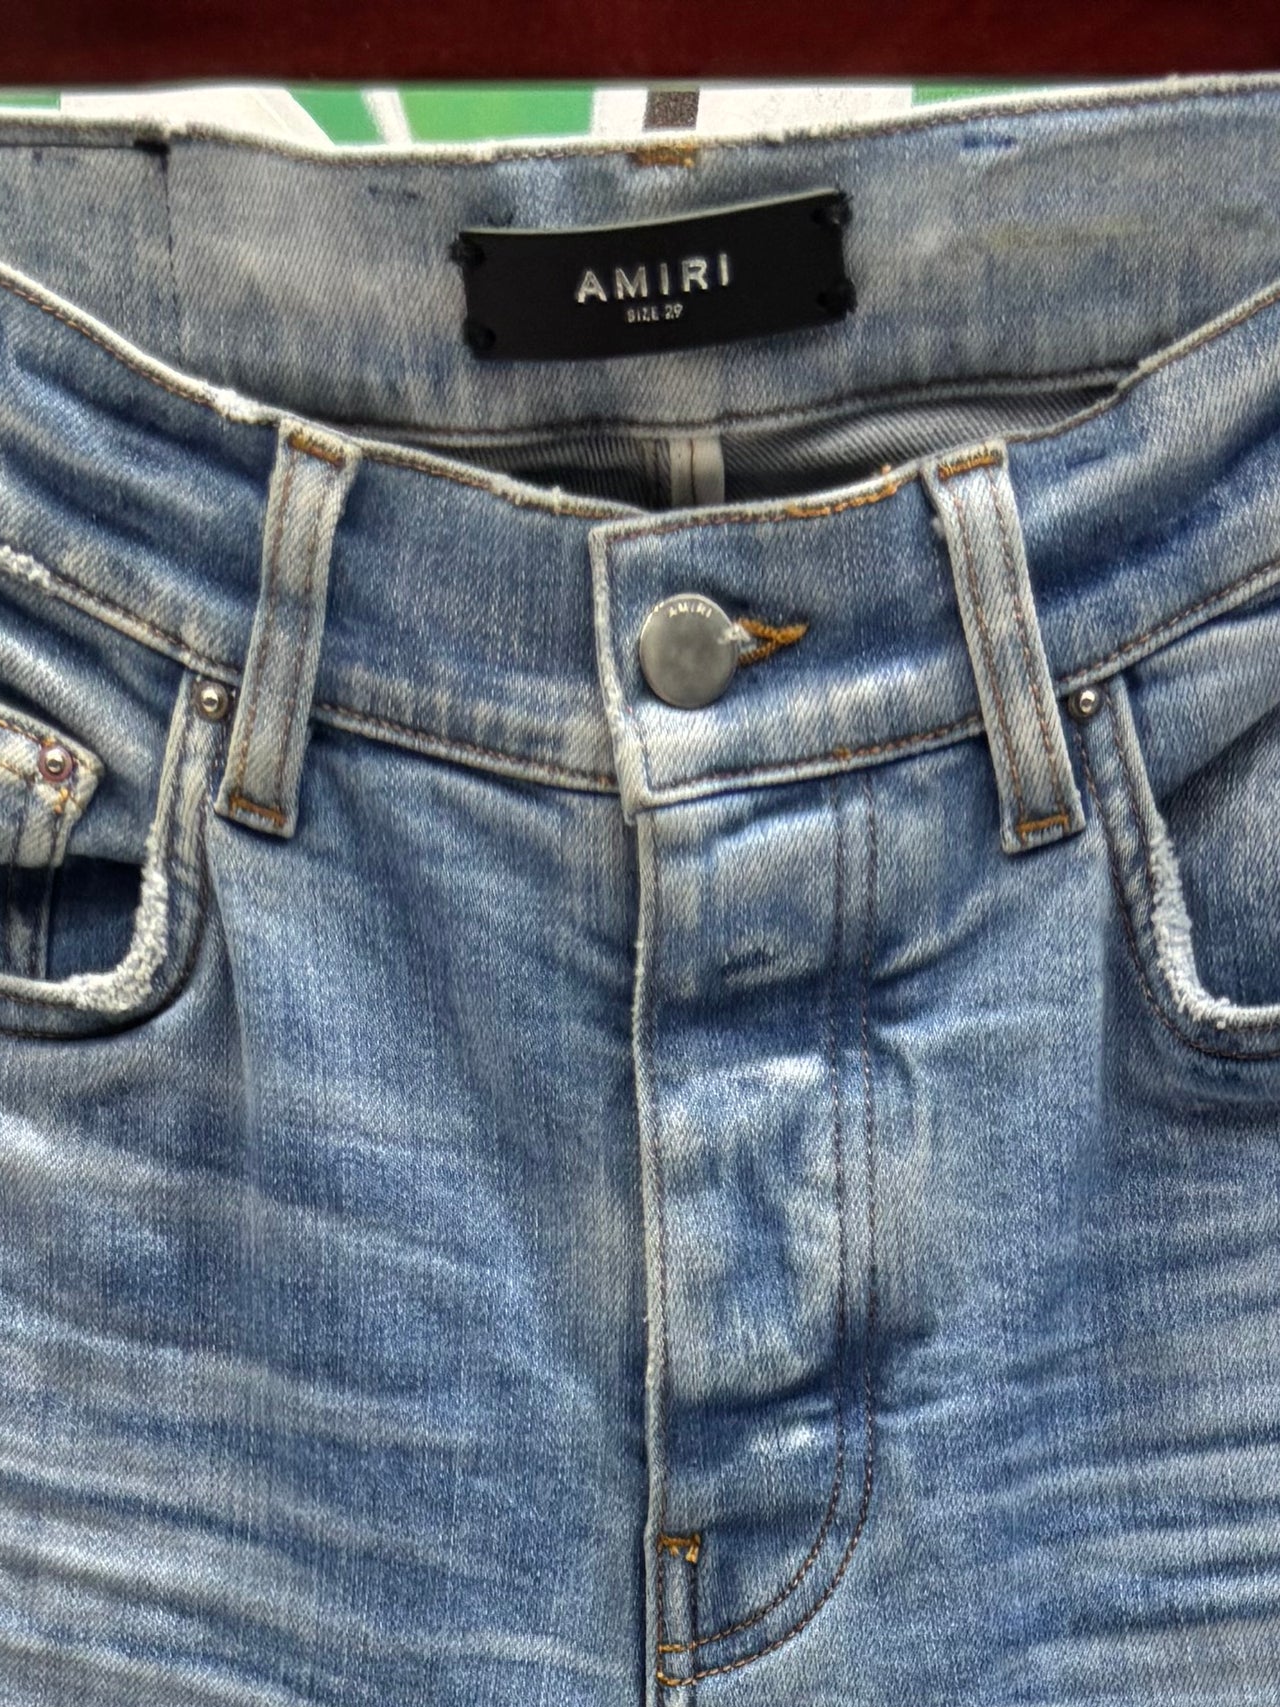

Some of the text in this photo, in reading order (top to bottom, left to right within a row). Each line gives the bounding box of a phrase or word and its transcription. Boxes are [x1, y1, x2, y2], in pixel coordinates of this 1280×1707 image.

[576, 253, 730, 304] AMIRI
[626, 303, 684, 323] SIZE 29
